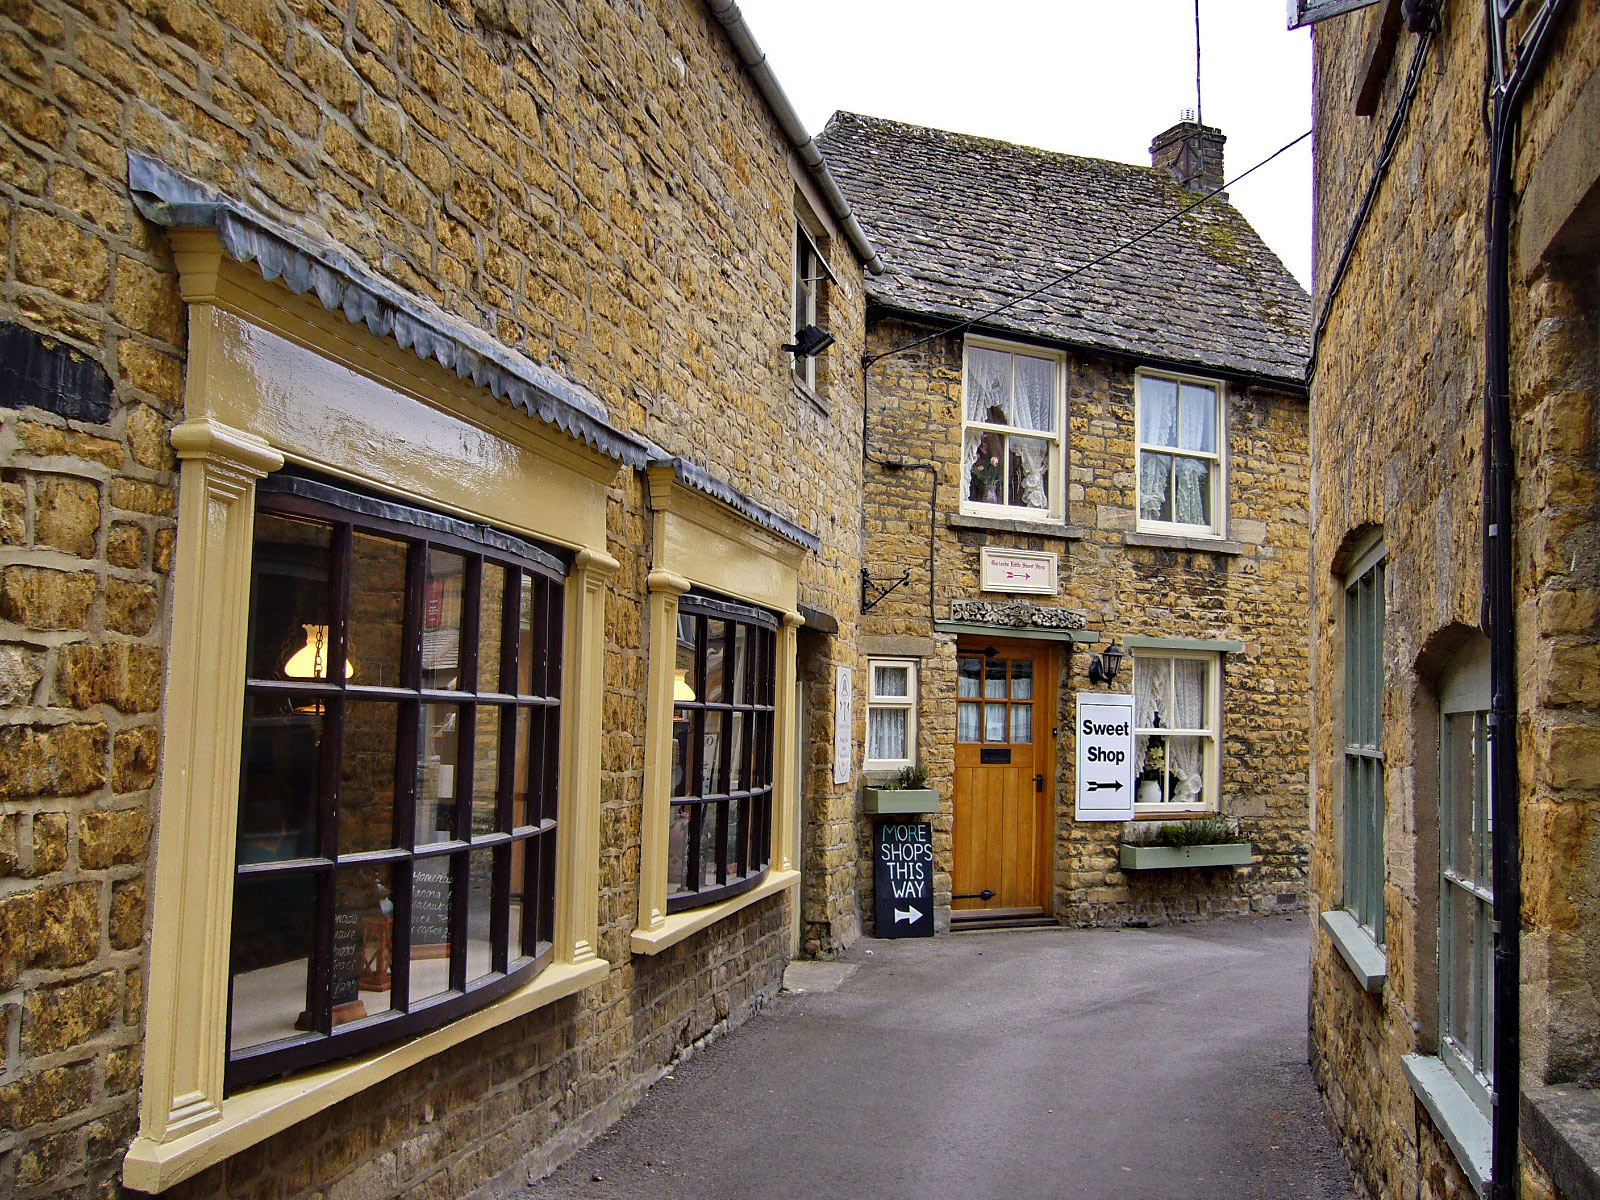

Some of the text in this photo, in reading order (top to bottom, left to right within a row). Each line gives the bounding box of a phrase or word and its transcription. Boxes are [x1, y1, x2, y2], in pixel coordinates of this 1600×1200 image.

[1082, 719, 1129, 736] Sweet
[1087, 746, 1125, 765] Shop
[882, 824, 926, 841] MORE
[881, 843, 933, 861] SHOPS
[886, 862, 925, 880] THIS
[891, 880, 925, 898] WAY
